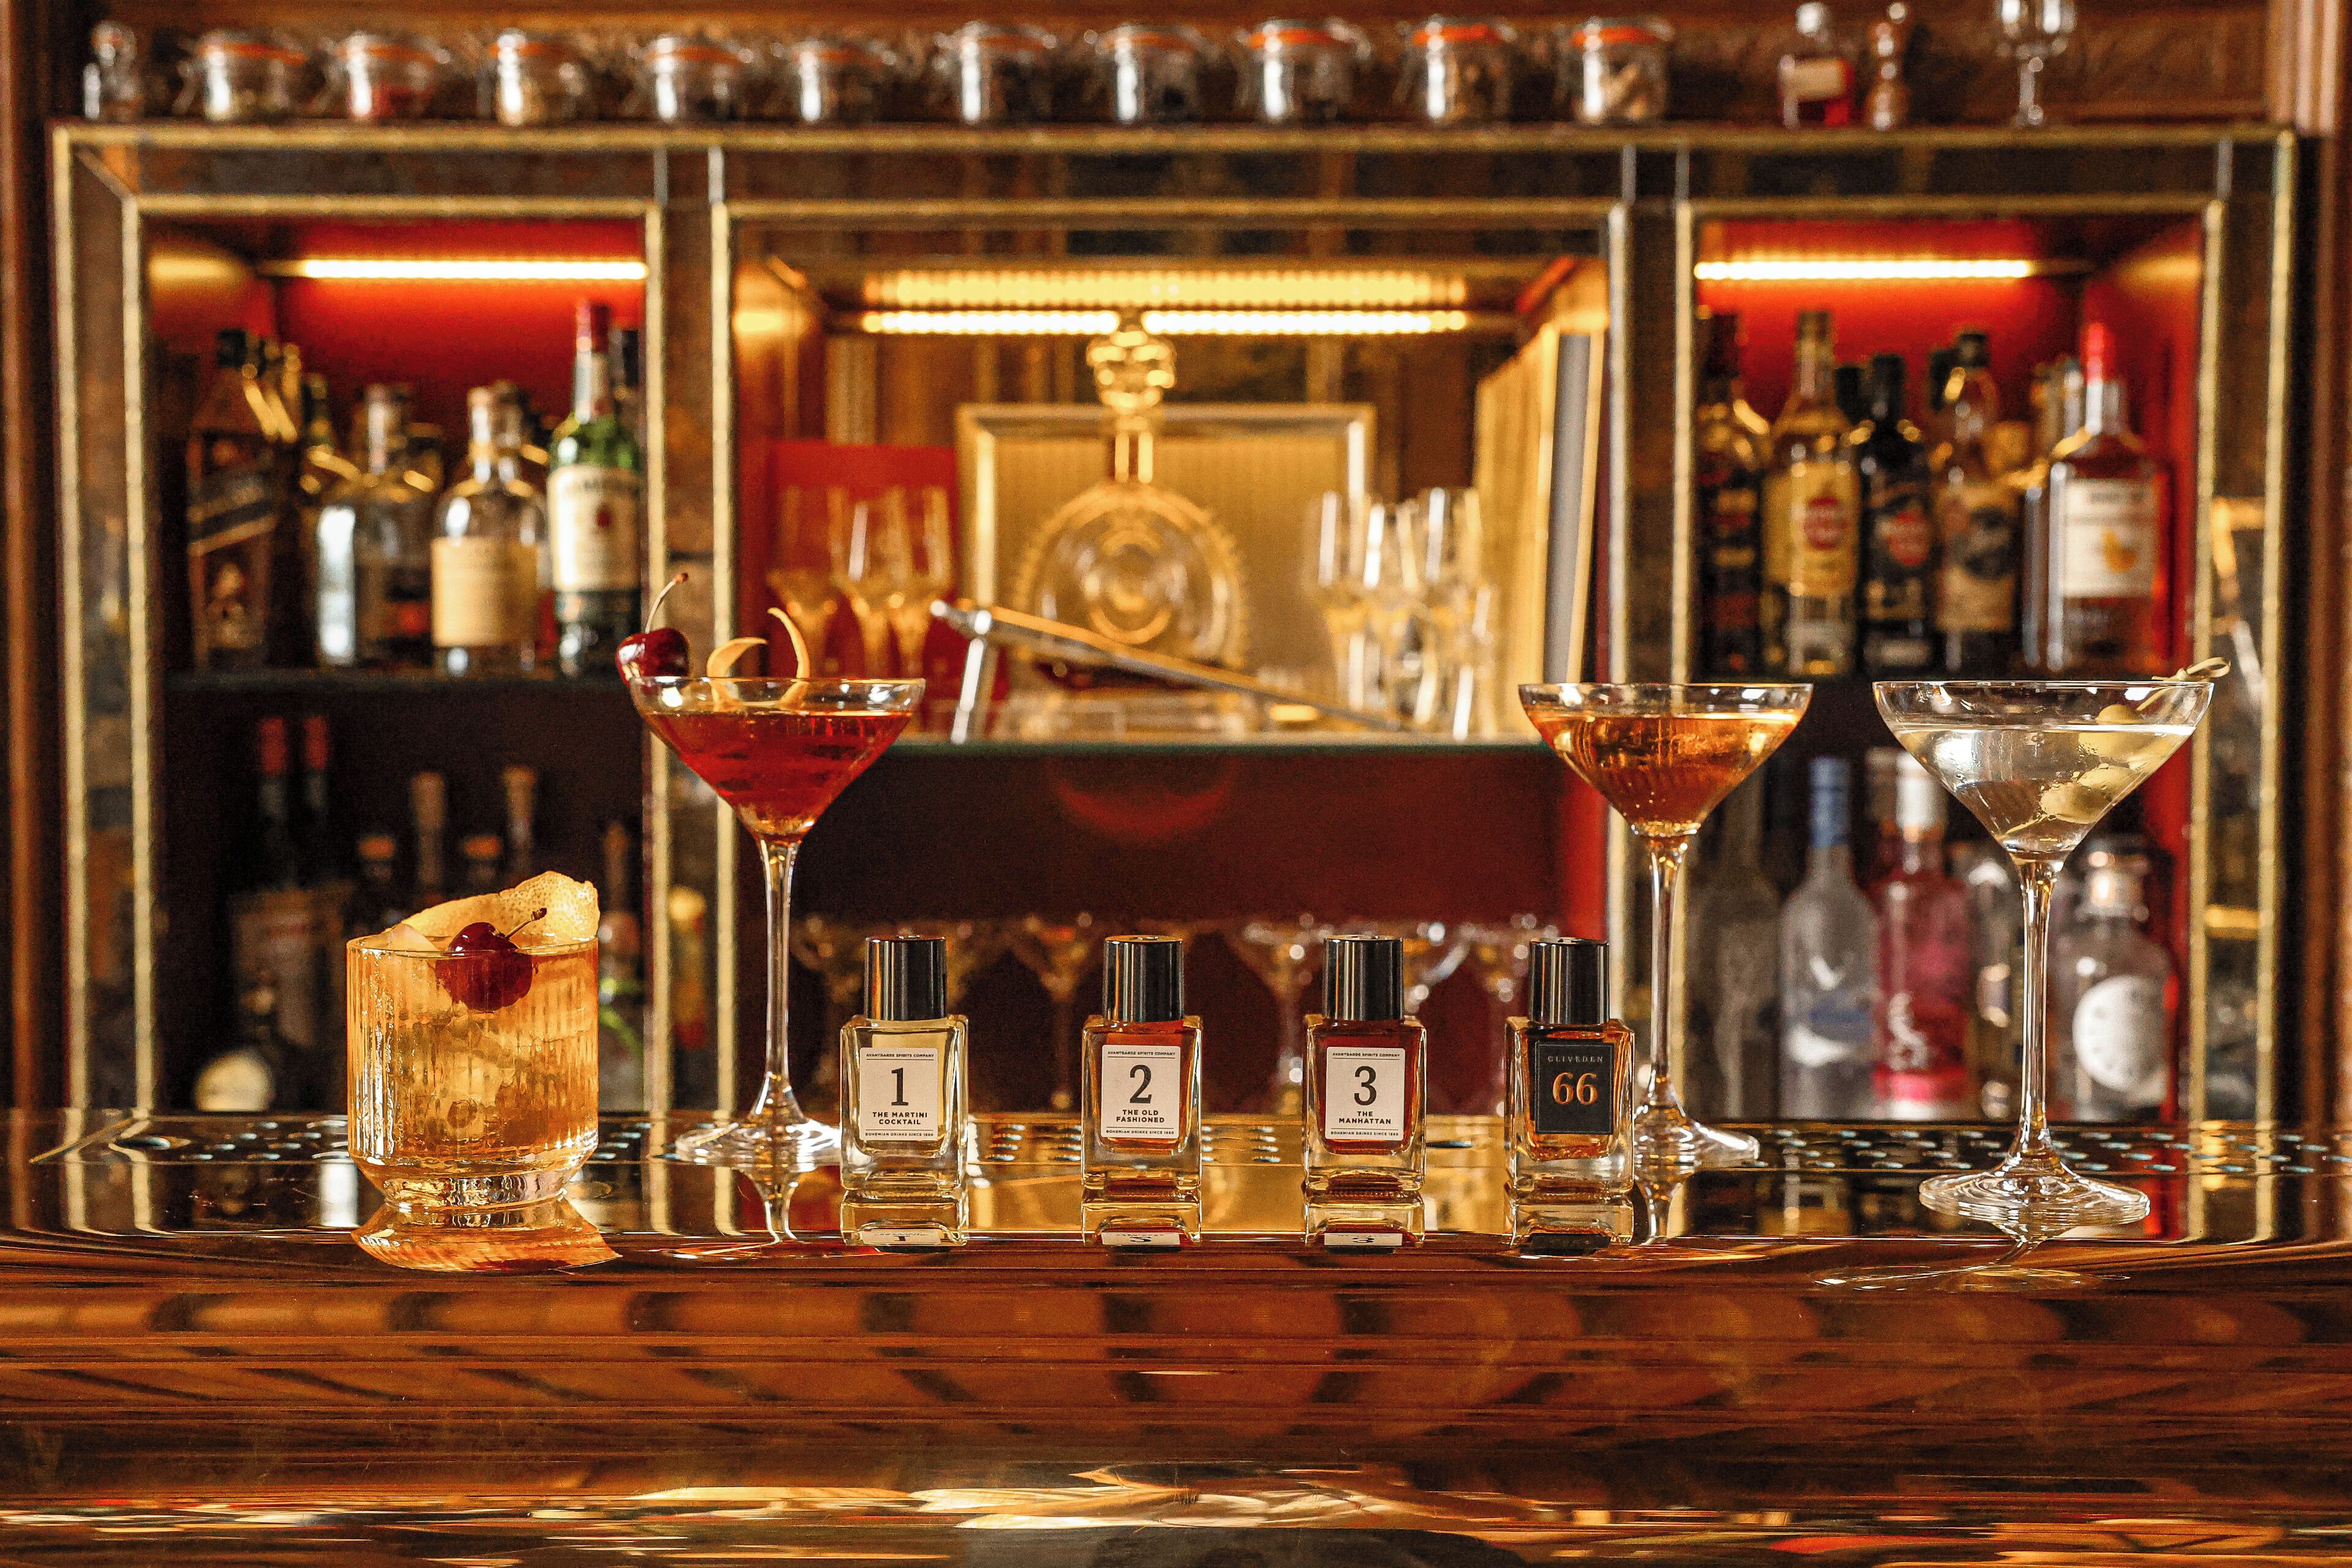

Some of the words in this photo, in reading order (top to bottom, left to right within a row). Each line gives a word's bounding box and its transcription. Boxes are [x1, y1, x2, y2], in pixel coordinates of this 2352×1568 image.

[891, 1067, 908, 1106] 1
[1129, 1065, 1152, 1104] 2
[1354, 1066, 1377, 1106] 3
[1553, 1072, 1598, 1105] 66
